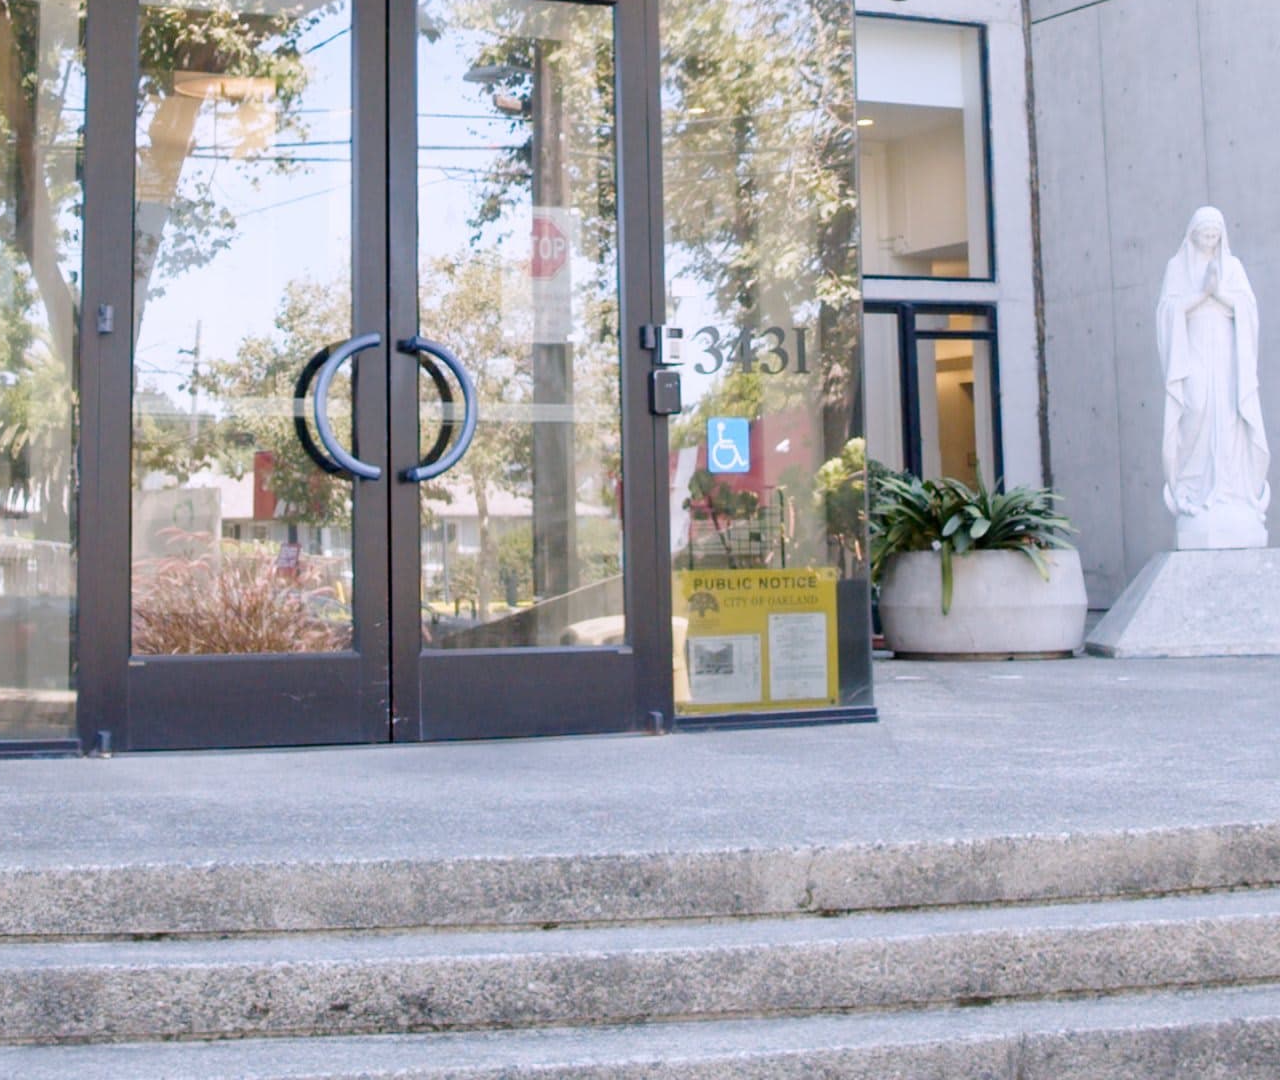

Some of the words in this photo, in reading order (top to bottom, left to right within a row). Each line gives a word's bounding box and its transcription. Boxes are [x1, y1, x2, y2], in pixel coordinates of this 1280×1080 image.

[527, 235, 566, 260] TOP
[691, 326, 811, 375] 3431
[693, 577, 752, 591] PUBLIC
[758, 575, 817, 590] NOTICE
[723, 597, 748, 608] CITY
[750, 597, 763, 607] OF
[767, 594, 819, 607] OAKLAND
